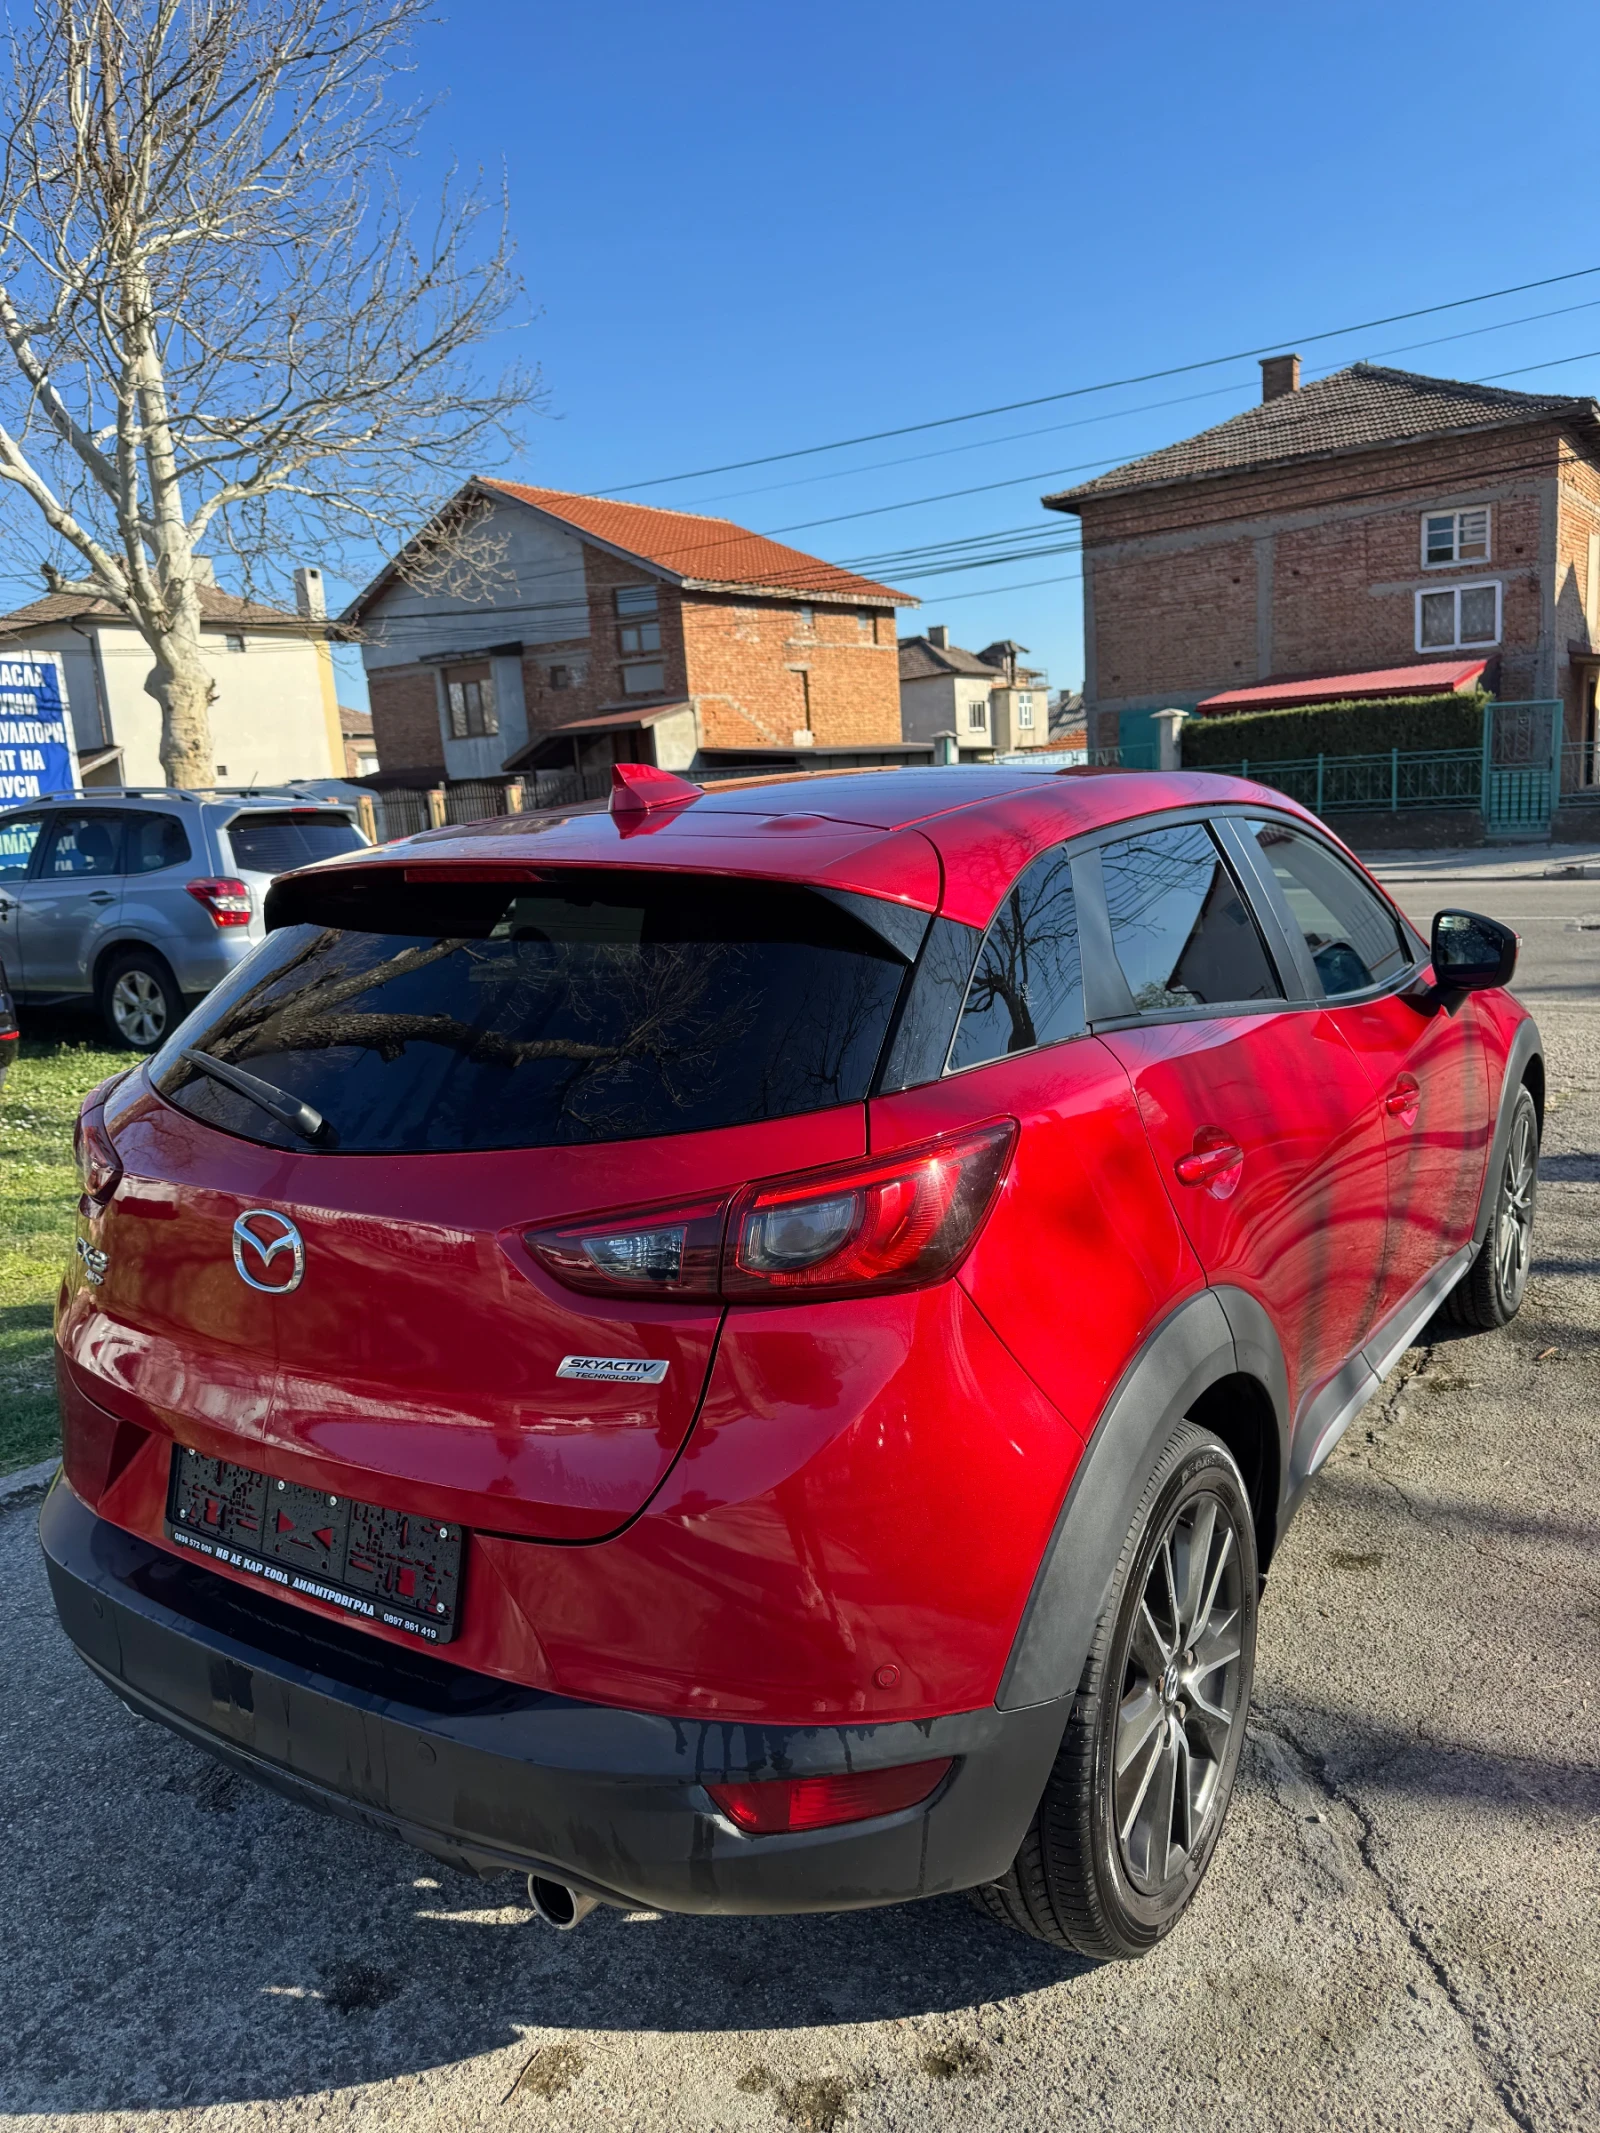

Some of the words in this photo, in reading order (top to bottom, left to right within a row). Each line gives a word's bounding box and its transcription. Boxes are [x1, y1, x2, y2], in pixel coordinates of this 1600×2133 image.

[0, 664, 47, 687] АСЛА
[0, 721, 65, 744] УЛАТОРИ
[20, 749, 46, 771] НА
[568, 1358, 657, 1372] SKYACTIV
[575, 1371, 644, 1382] TECHNOLOGY
[215, 1547, 229, 1560] ИВ
[229, 1553, 242, 1566] ДЕ
[243, 1558, 263, 1573] КАР
[264, 1566, 289, 1584] ЕООД
[292, 1577, 375, 1617] ДИМИТРОВГРАД
[383, 1612, 403, 1627] 0897
[404, 1619, 419, 1633] 861
[420, 1626, 437, 1639] 419
